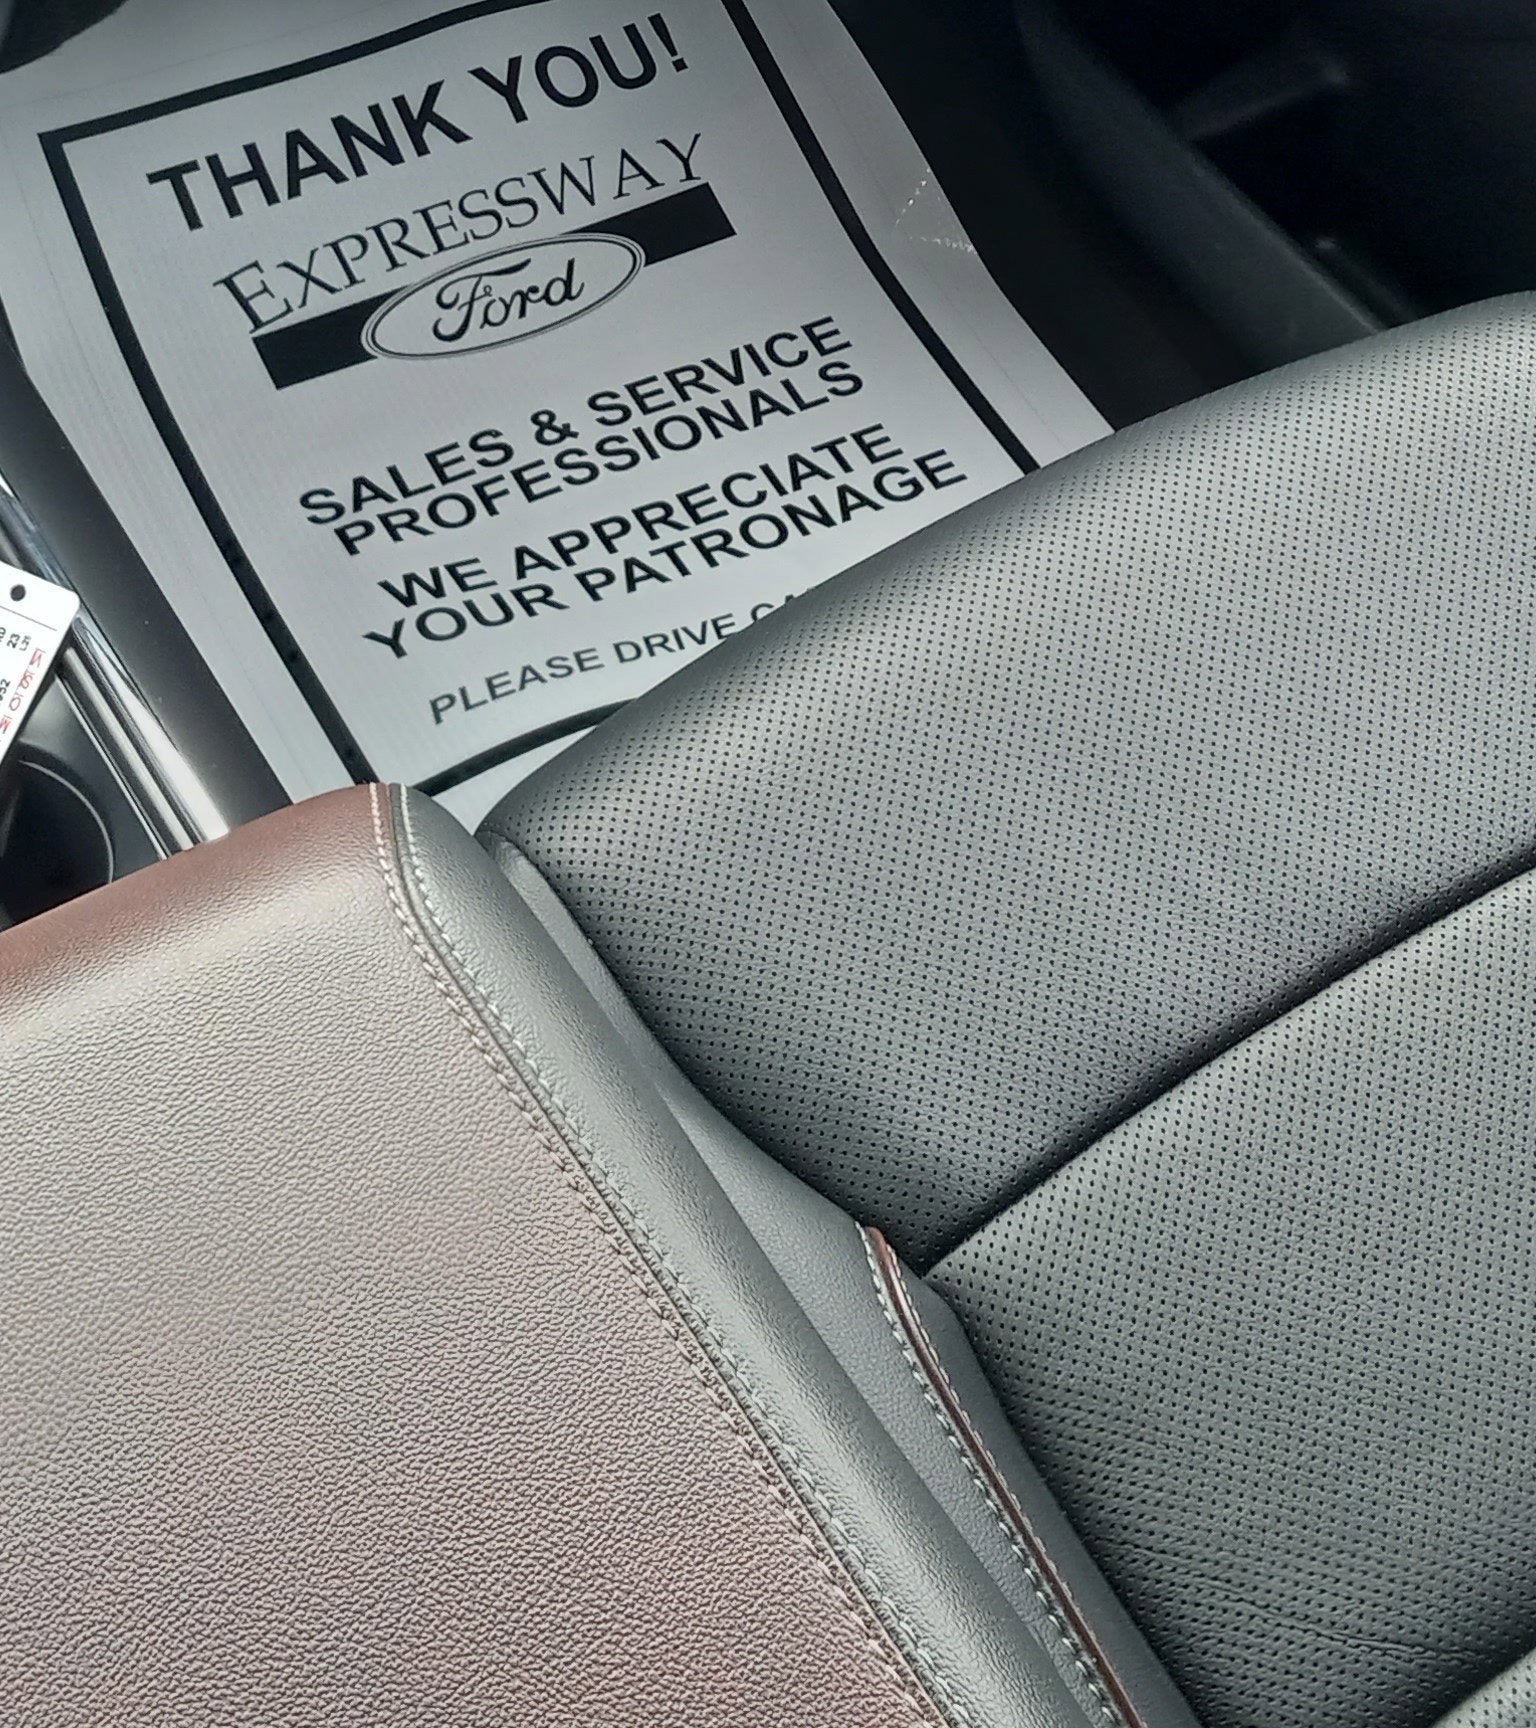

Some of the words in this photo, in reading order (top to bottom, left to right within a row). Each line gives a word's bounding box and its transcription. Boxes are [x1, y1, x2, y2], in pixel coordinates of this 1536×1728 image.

[146, 79, 473, 232] THANK
[468, 12, 689, 124] YOU!
[431, 258, 587, 344] Ford
[298, 427, 515, 527] SALES
[529, 407, 580, 446] &
[586, 315, 855, 427] SERVICE
[333, 359, 865, 557] PROFESSIONALS
[377, 556, 498, 609] WE
[513, 422, 905, 581] APPRECIATE
[6, 632, 21, 649] 23
[363, 581, 571, 661] YOUR
[574, 448, 969, 602] PATRONAGE
[427, 647, 606, 725] PLEASE
[612, 612, 740, 664] DRIVE
